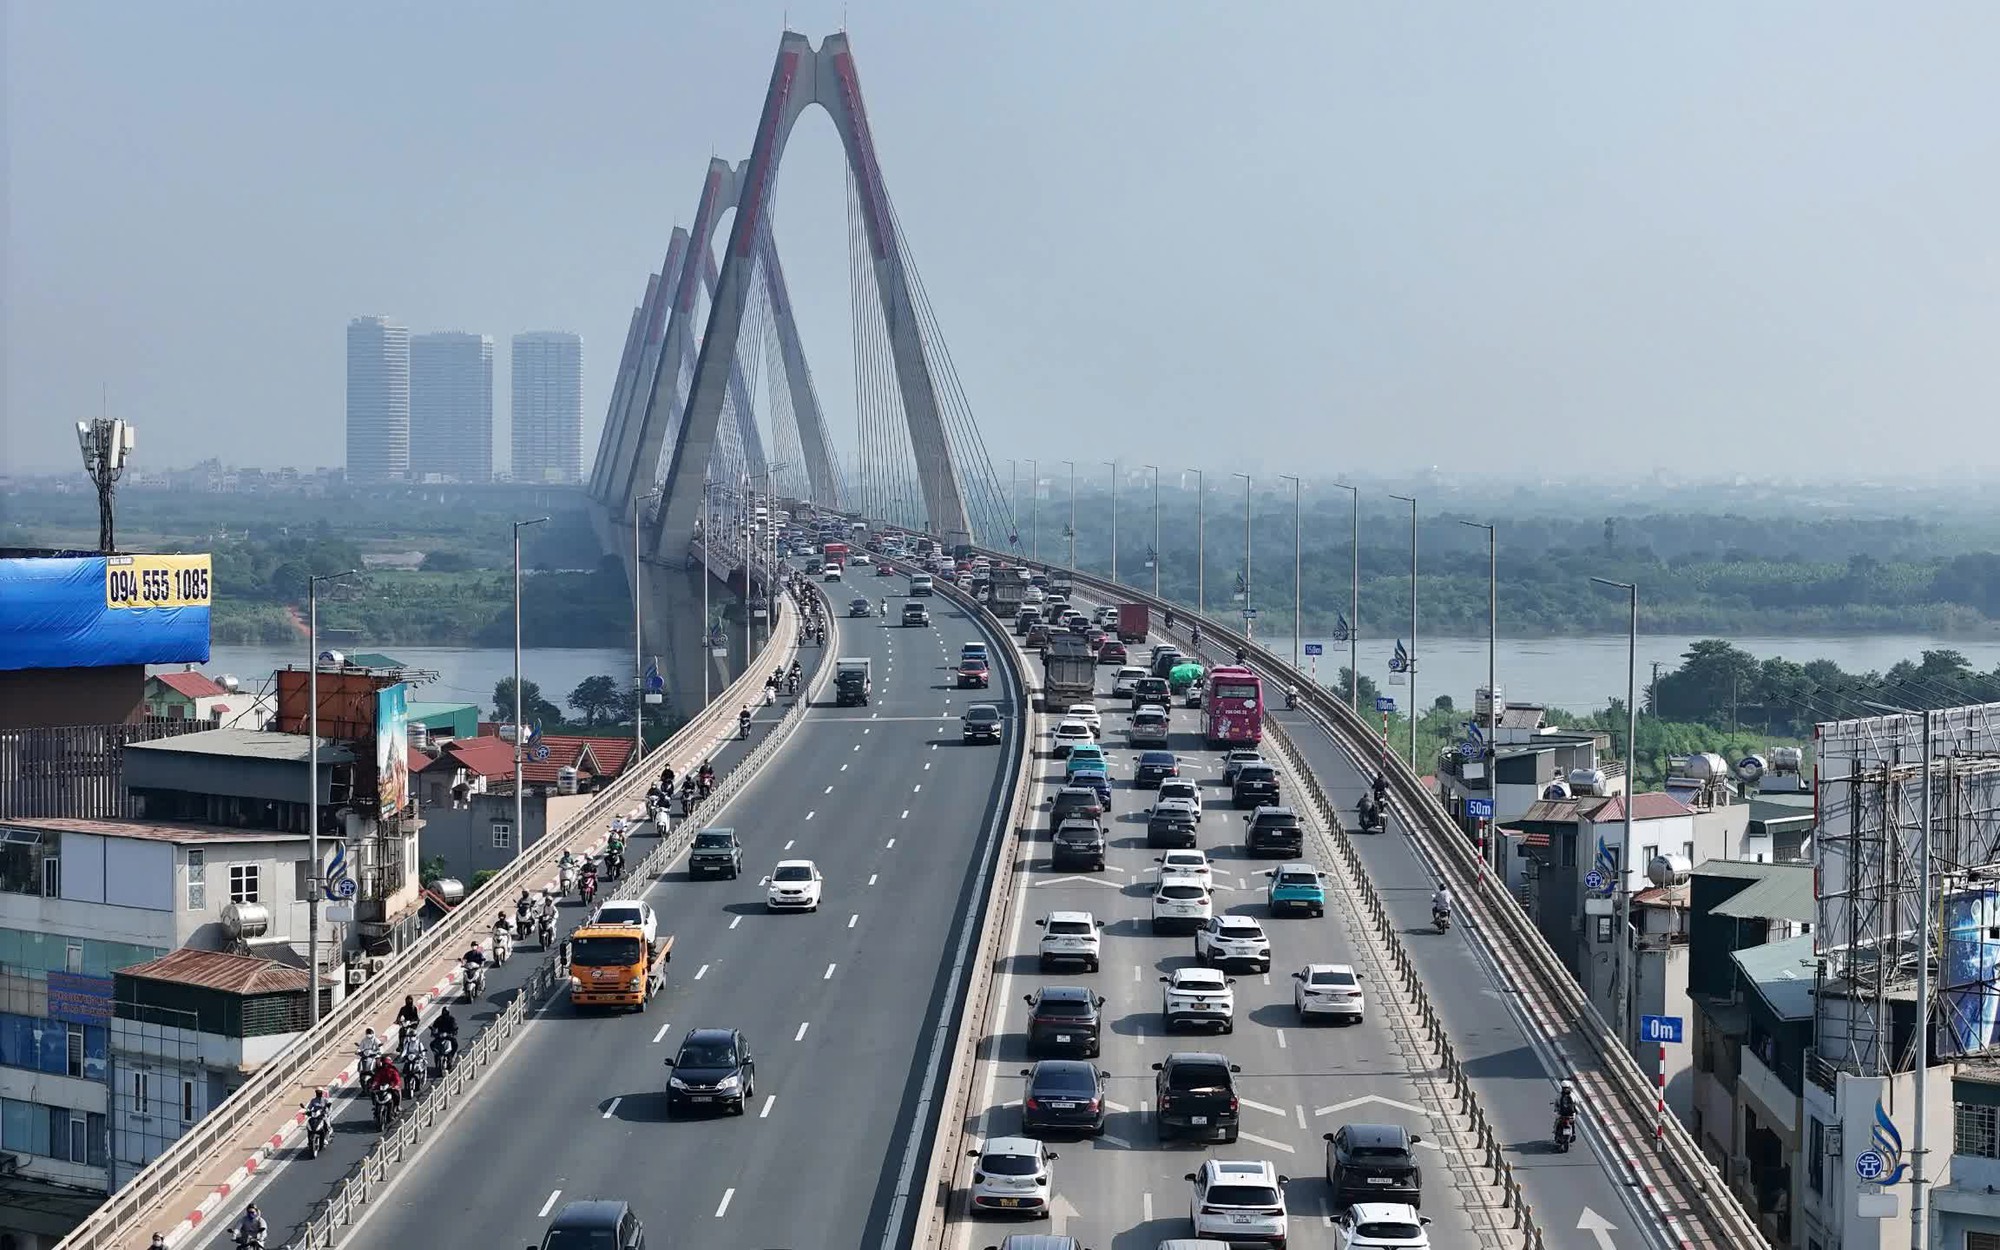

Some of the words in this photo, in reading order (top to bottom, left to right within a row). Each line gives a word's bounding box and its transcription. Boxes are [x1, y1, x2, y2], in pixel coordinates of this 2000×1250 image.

[110, 570, 138, 602] 094
[142, 570, 170, 601] 555
[174, 569, 208, 600] 1085
[1306, 646, 1322, 654] 150m
[1378, 700, 1393, 710] 100m
[1470, 801, 1491, 815] 50m
[1651, 1019, 1673, 1039] 0m
